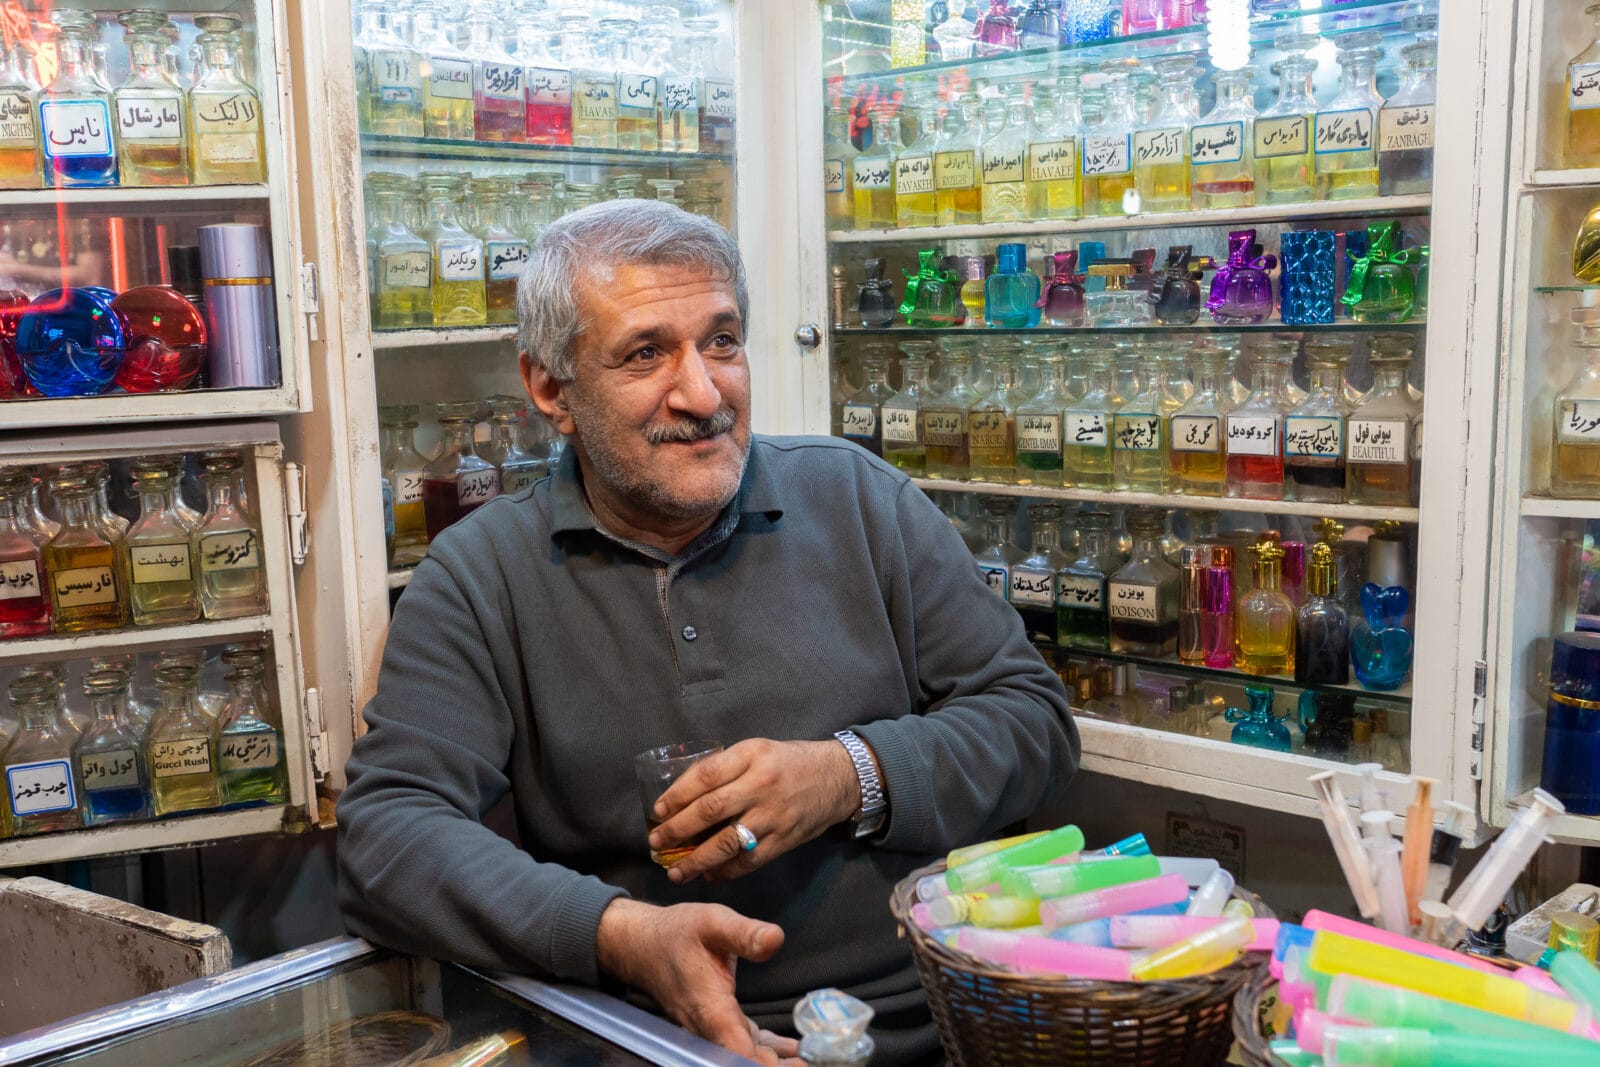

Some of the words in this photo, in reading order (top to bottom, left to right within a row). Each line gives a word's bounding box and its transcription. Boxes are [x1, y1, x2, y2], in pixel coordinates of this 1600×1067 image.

[122, 106, 177, 128] مارشال
[49, 116, 100, 146] نایس
[1387, 135, 1431, 149] ZANBAGH
[1038, 148, 1068, 164] هاوایی
[1352, 446, 1396, 460] BEAUTIFUL
[137, 554, 184, 567] بهشت
[1111, 605, 1155, 619] POISON
[155, 761, 182, 770] Gucci
[184, 757, 208, 767] Rush
